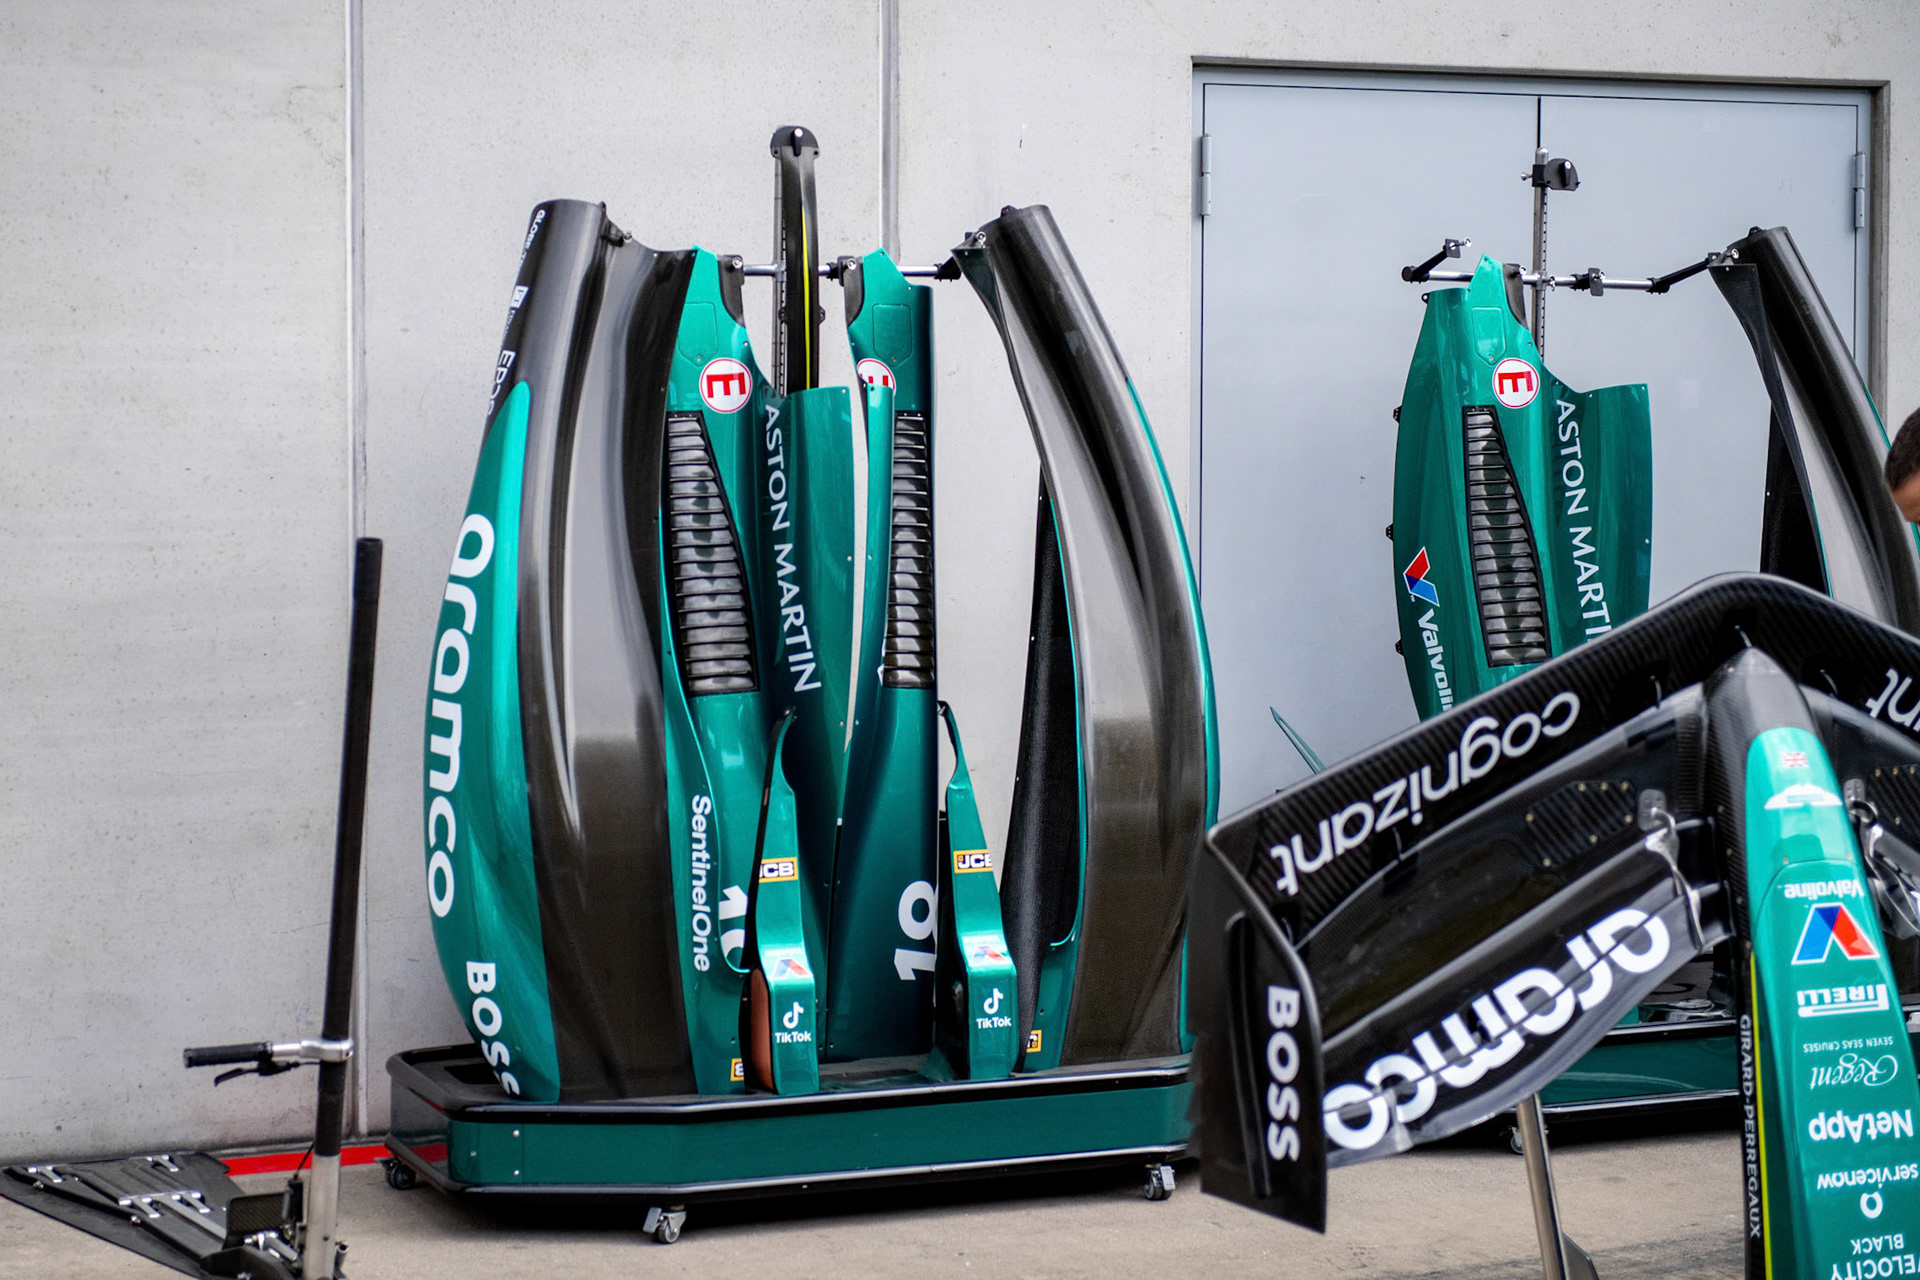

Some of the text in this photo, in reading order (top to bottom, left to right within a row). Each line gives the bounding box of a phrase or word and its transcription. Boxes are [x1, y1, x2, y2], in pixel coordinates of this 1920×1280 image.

[706, 372, 747, 398] E
[1497, 371, 1534, 395] E
[1556, 399, 1614, 643] ASTON MARTI
[765, 403, 822, 693] ASTON MARTIN
[428, 513, 495, 918] aramco
[1269, 691, 1581, 896] cognizant
[691, 794, 713, 972] SentinelOne
[1784, 879, 1865, 900] Valvoline
[1797, 983, 1890, 1018] PIRELLI
[774, 1031, 812, 1044] TikTok
[976, 1016, 1012, 1029] TikTok
[1322, 908, 1671, 1150] aramco
[1802, 1036, 1894, 1053] SEVEN SEAS CRUISES
[1266, 984, 1300, 1163] BOSS
[1809, 1053, 1898, 1090] Regent
[1739, 1014, 1761, 1239] GIRARD-PERREGAUX
[1808, 1109, 1914, 1143] NetApp
[1817, 1163, 1919, 1190] servicenow
[1851, 1233, 1905, 1255] BLACK
[1830, 1254, 1920, 1280] ELOCITY
